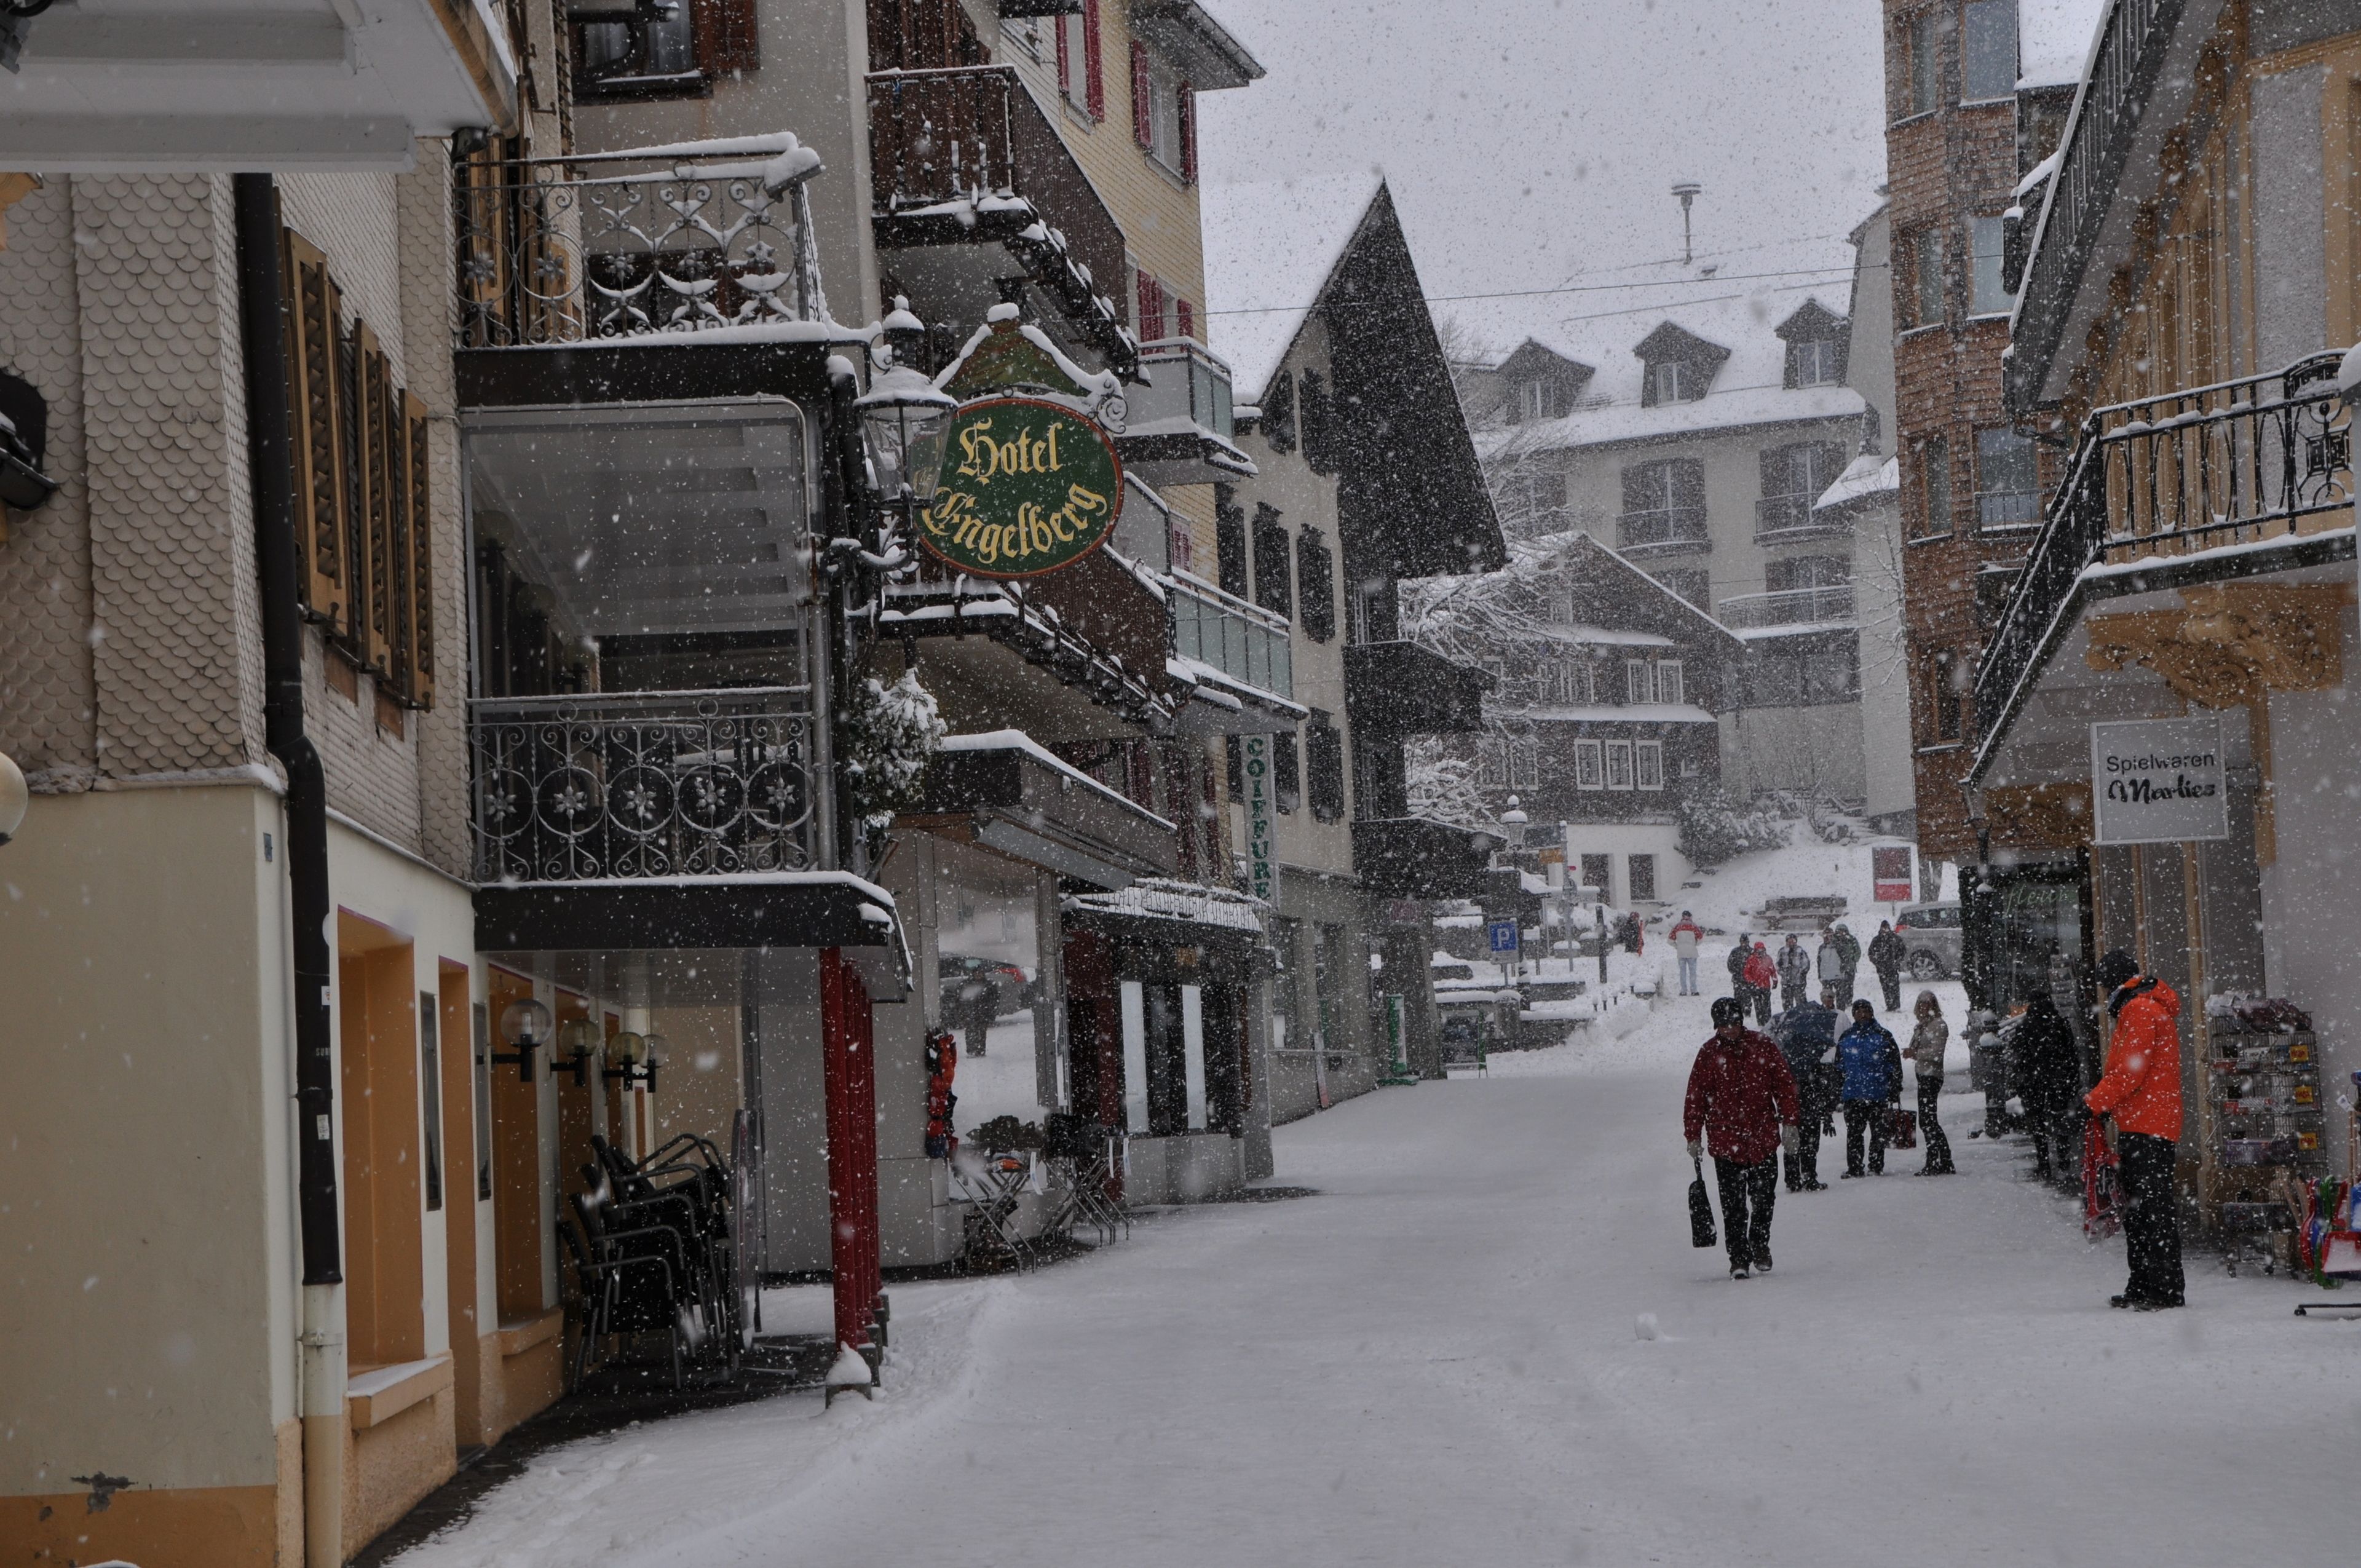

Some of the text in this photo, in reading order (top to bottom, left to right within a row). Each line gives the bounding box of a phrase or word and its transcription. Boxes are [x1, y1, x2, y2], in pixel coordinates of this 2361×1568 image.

[956, 417, 1062, 486] Hotel
[922, 482, 1107, 564] Engelberg
[2106, 754, 2215, 774] Spielwaren
[2108, 774, 2216, 804] Marlies
[1247, 738, 1271, 900] COIFFURE
[1497, 928, 1510, 949] P
